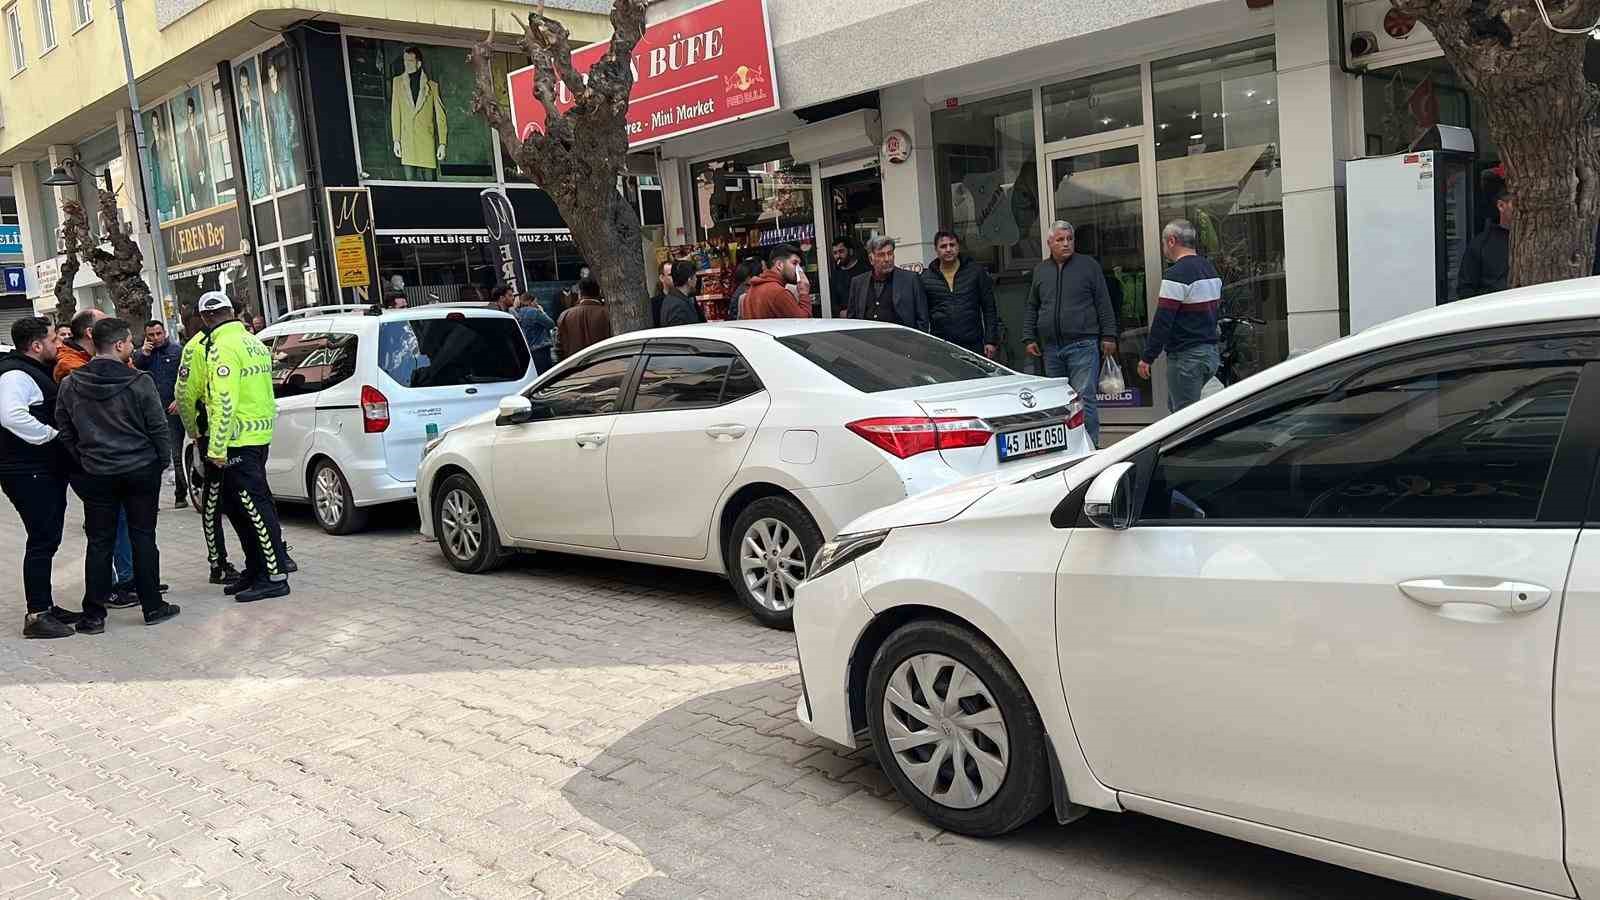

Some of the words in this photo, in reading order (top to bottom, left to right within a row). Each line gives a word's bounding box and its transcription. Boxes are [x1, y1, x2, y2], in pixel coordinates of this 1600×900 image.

[650, 26, 723, 78] BÜFE
[625, 121, 642, 134] rez
[651, 108, 674, 130] Mini
[676, 98, 714, 124] Market
[206, 222, 224, 250] Bey
[393, 236, 430, 244] TAKIM
[433, 234, 473, 243] ELBİSE
[1095, 393, 1133, 401] WORLD
[1007, 435, 1019, 453] 45
[1025, 431, 1043, 450] AHE
